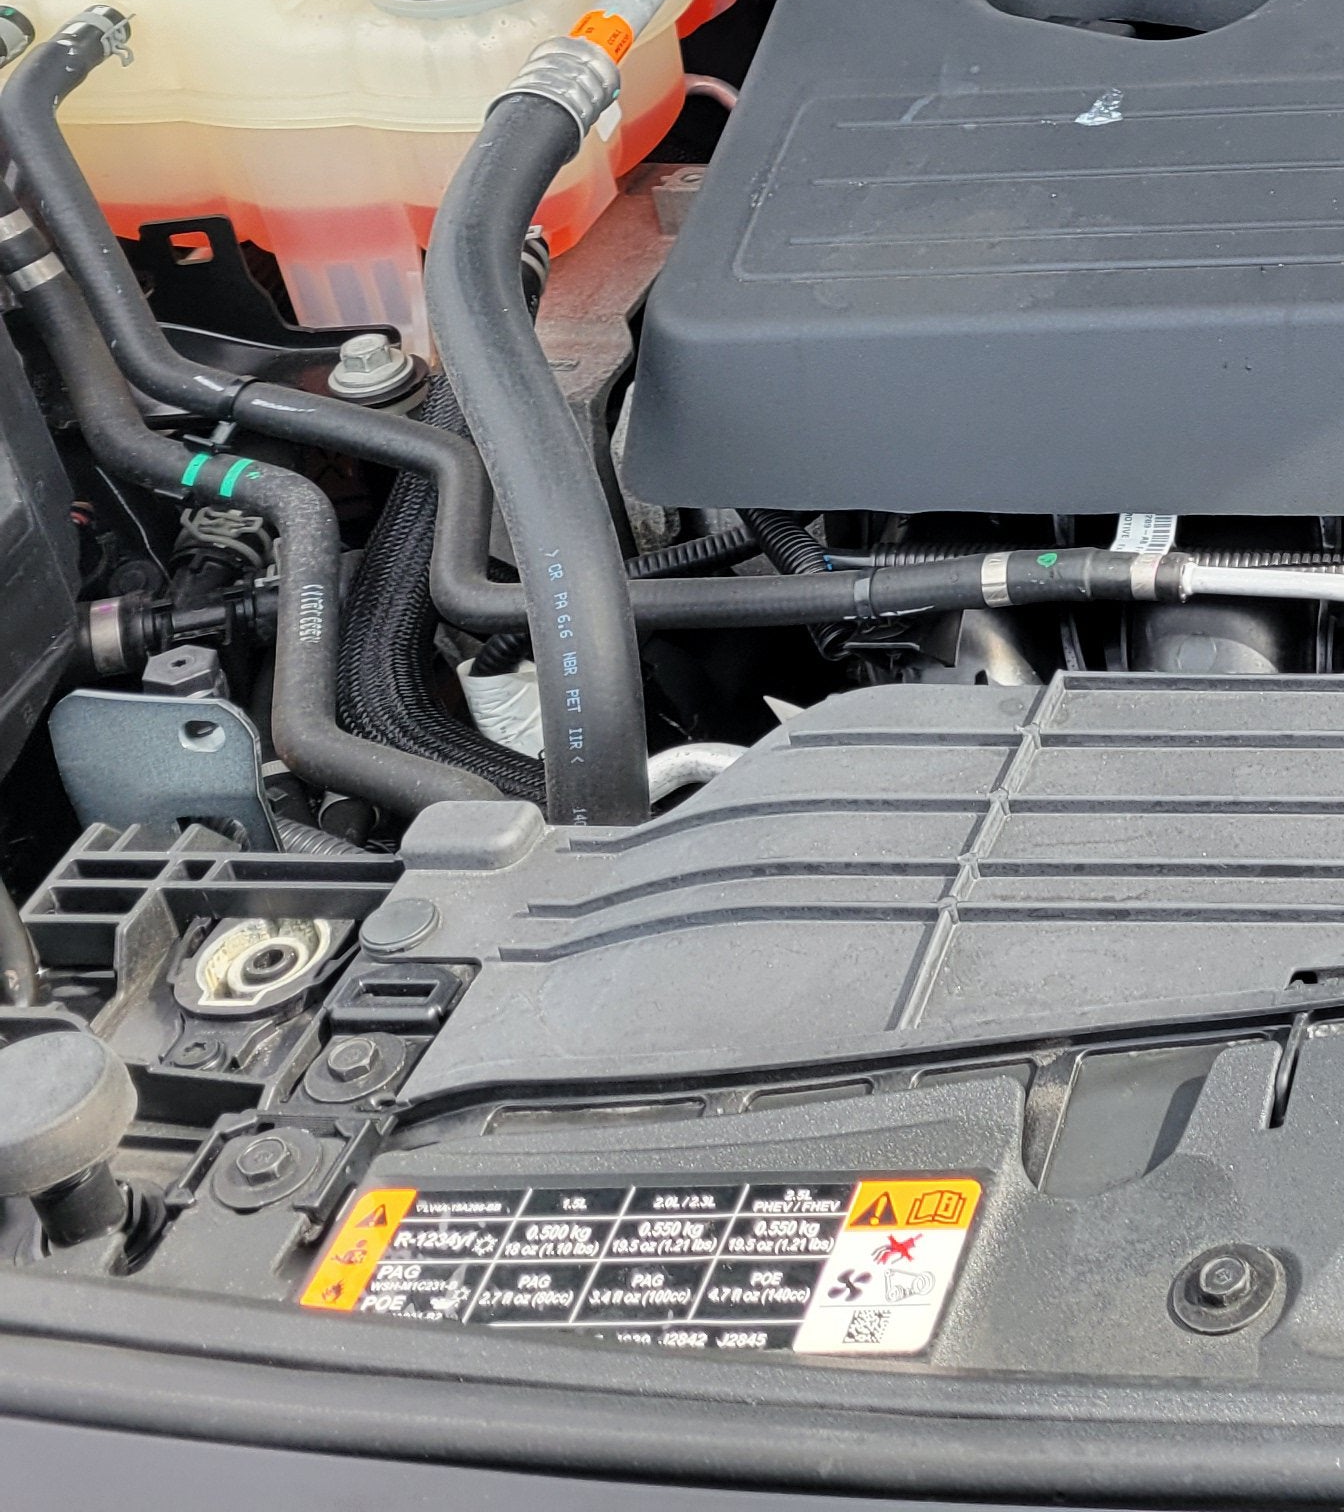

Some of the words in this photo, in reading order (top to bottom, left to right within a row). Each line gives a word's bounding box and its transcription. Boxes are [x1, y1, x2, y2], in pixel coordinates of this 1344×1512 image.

[554, 592, 569, 610] PA
[557, 614, 573, 639] 6.6
[562, 652, 578, 676] NBR
[565, 689, 581, 713] PET
[653, 1196, 680, 1209] 2.0L
[689, 1195, 716, 1209] 2.3L
[784, 1189, 812, 1201] 2.5L
[562, 1198, 587, 1210] 1.5L
[753, 1201, 791, 1212] PHEV
[802, 1200, 840, 1212] FHEV
[525, 1225, 569, 1240] 0.500
[570, 1225, 592, 1242] kg
[638, 1222, 681, 1237] 0.550
[682, 1222, 704, 1239] kg
[754, 1221, 798, 1237] 0.550
[799, 1220, 820, 1238] kg
[394, 1231, 477, 1250] R-1234yf
[612, 1239, 639, 1253] 19.5
[640, 1241, 657, 1253] oz
[657, 1239, 691, 1255] (1.21
[692, 1238, 717, 1253] lbs)
[728, 1238, 755, 1252] 19.5
[757, 1241, 774, 1252] oz
[774, 1239, 807, 1255] (1.21
[808, 1238, 835, 1253] lbs)
[505, 1242, 520, 1255] 18
[521, 1244, 538, 1255] oz
[538, 1242, 572, 1258] (1.10
[573, 1241, 599, 1256] lbs)
[377, 1265, 421, 1279] PAG
[631, 1273, 664, 1288] PAG
[750, 1272, 783, 1287] POE
[517, 1274, 551, 1288] PAG
[361, 1296, 406, 1311] POE
[479, 1291, 501, 1305] 2.7
[514, 1293, 531, 1304] oz
[589, 1290, 611, 1305] 3.4
[624, 1292, 641, 1303] oz
[641, 1289, 691, 1308] (100cc)
[708, 1288, 731, 1303] 4.7
[743, 1291, 760, 1302] oz
[761, 1287, 811, 1306] (140cc)
[716, 1332, 767, 1349] J2845
